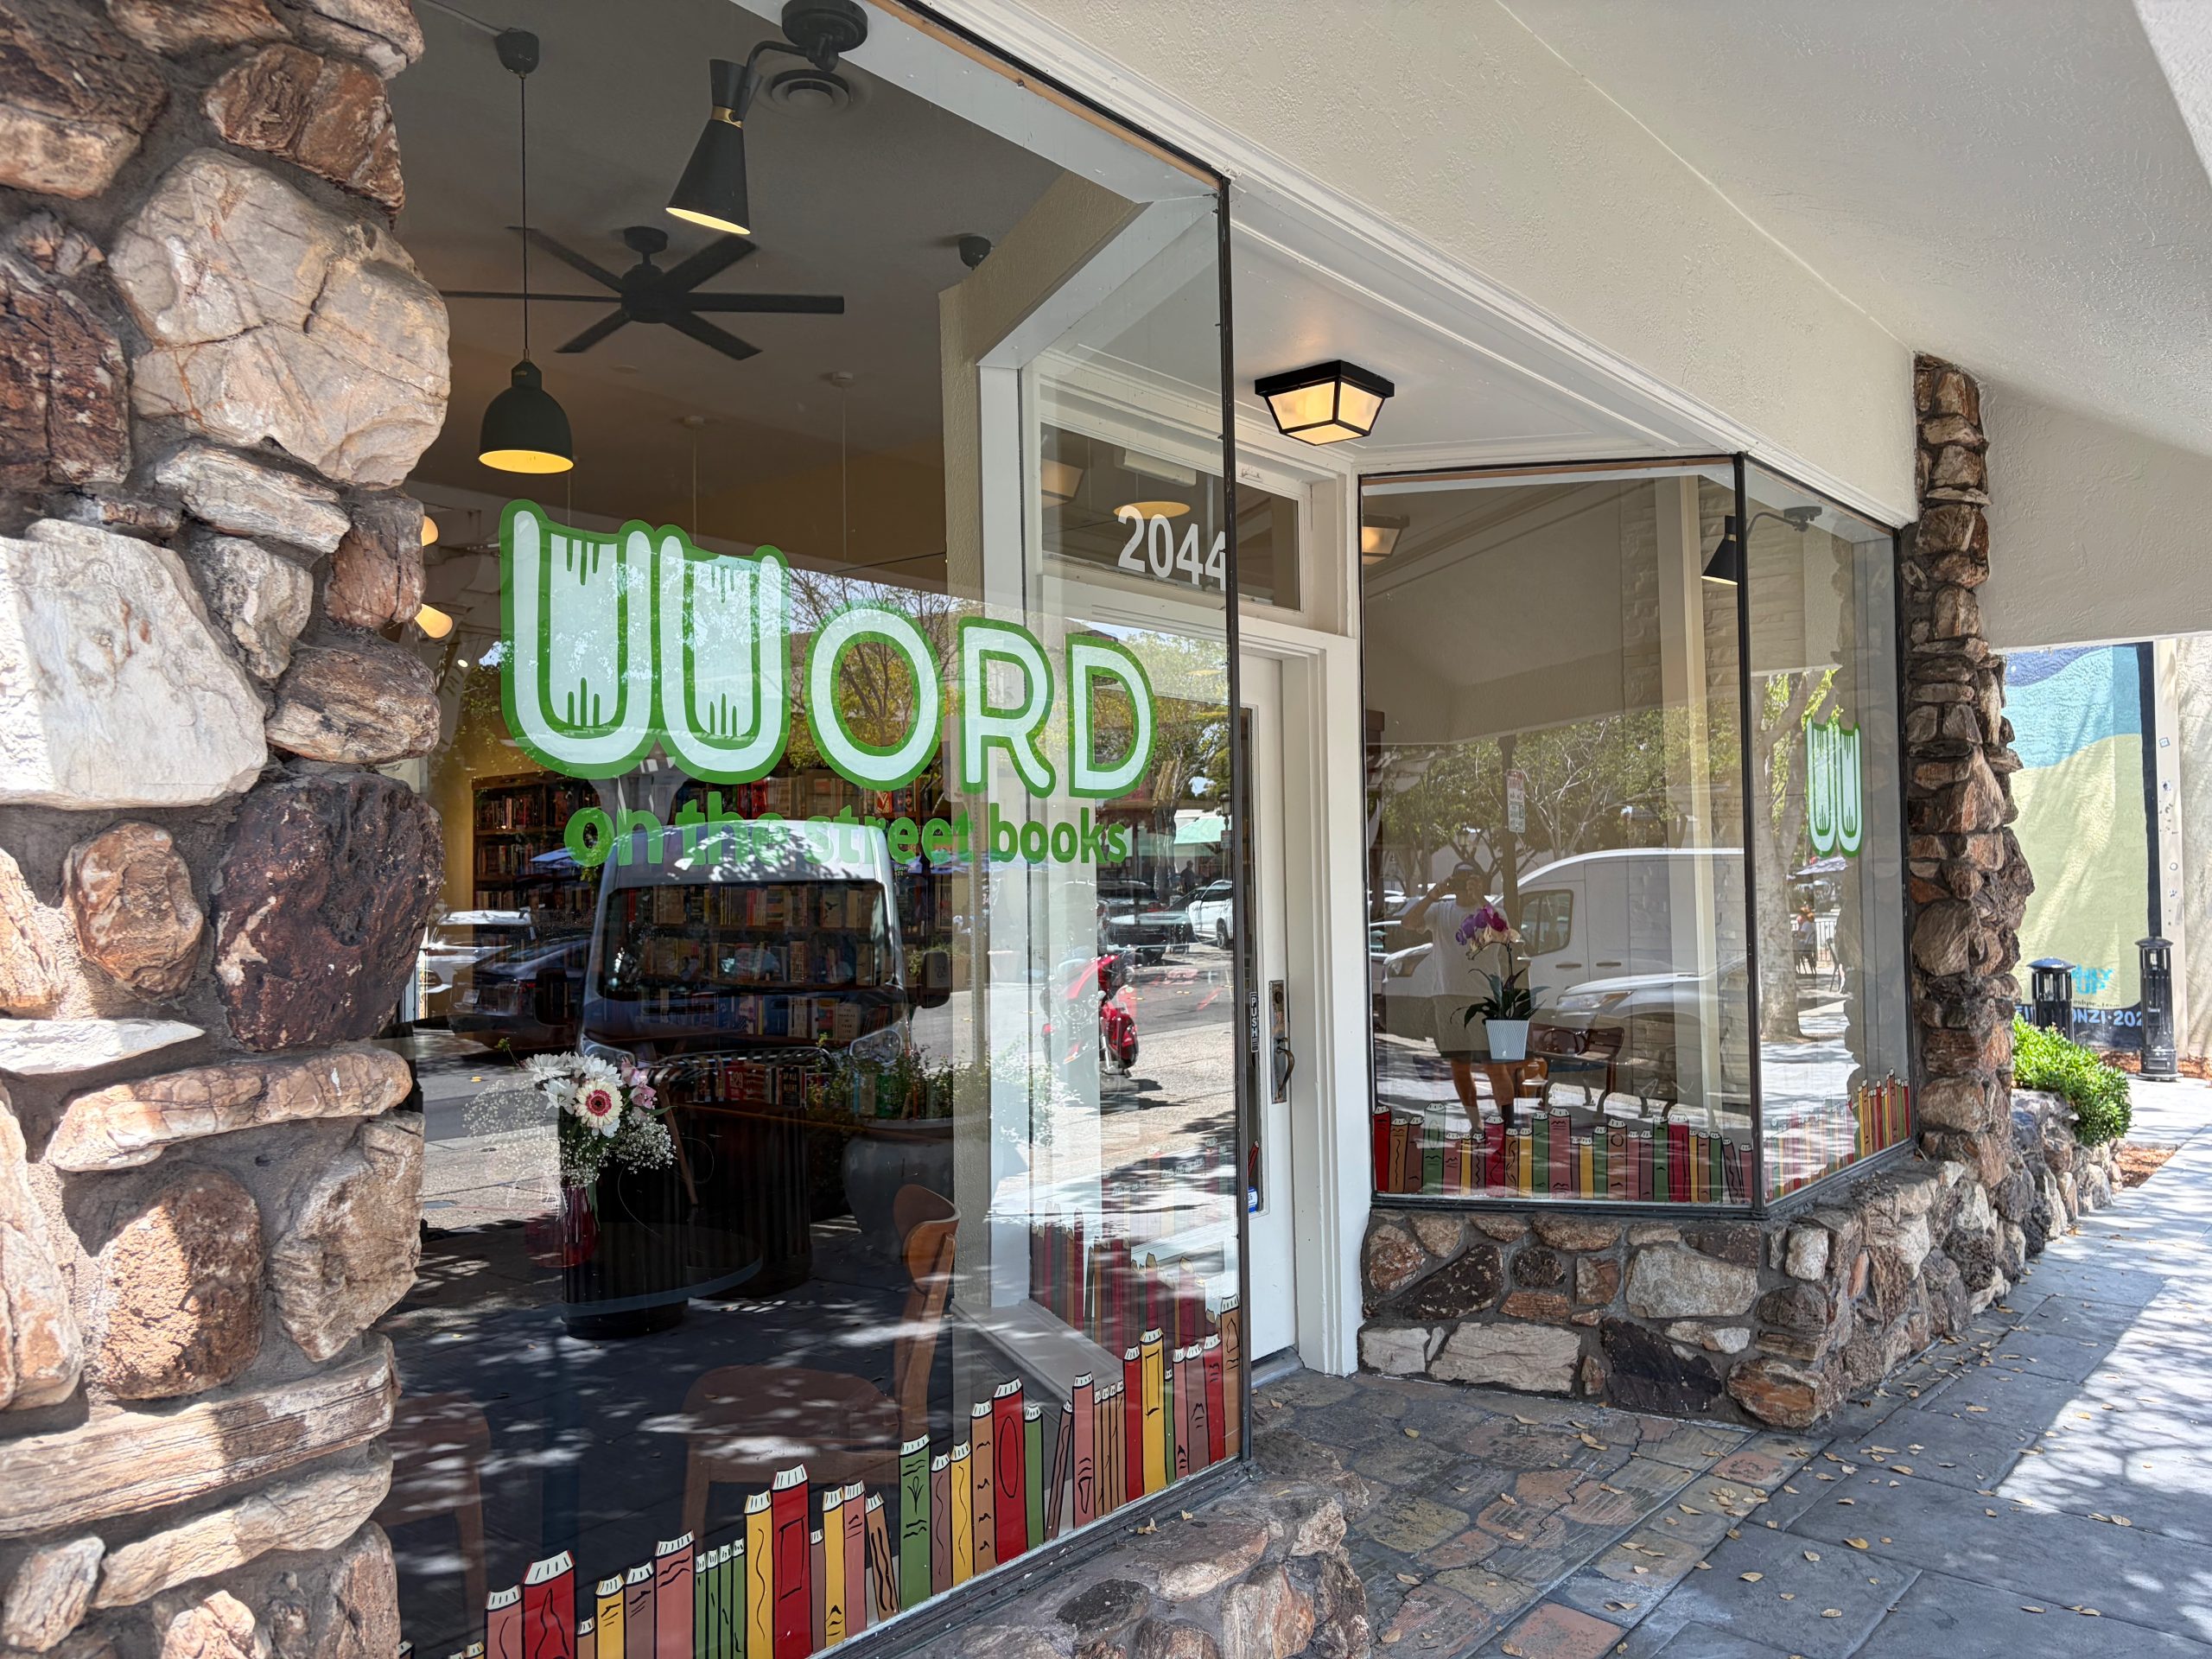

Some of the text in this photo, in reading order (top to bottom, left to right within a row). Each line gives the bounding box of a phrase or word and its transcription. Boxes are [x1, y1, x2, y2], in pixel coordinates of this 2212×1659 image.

[1118, 505, 1225, 591] 2044
[564, 791, 1127, 867] on the street books
